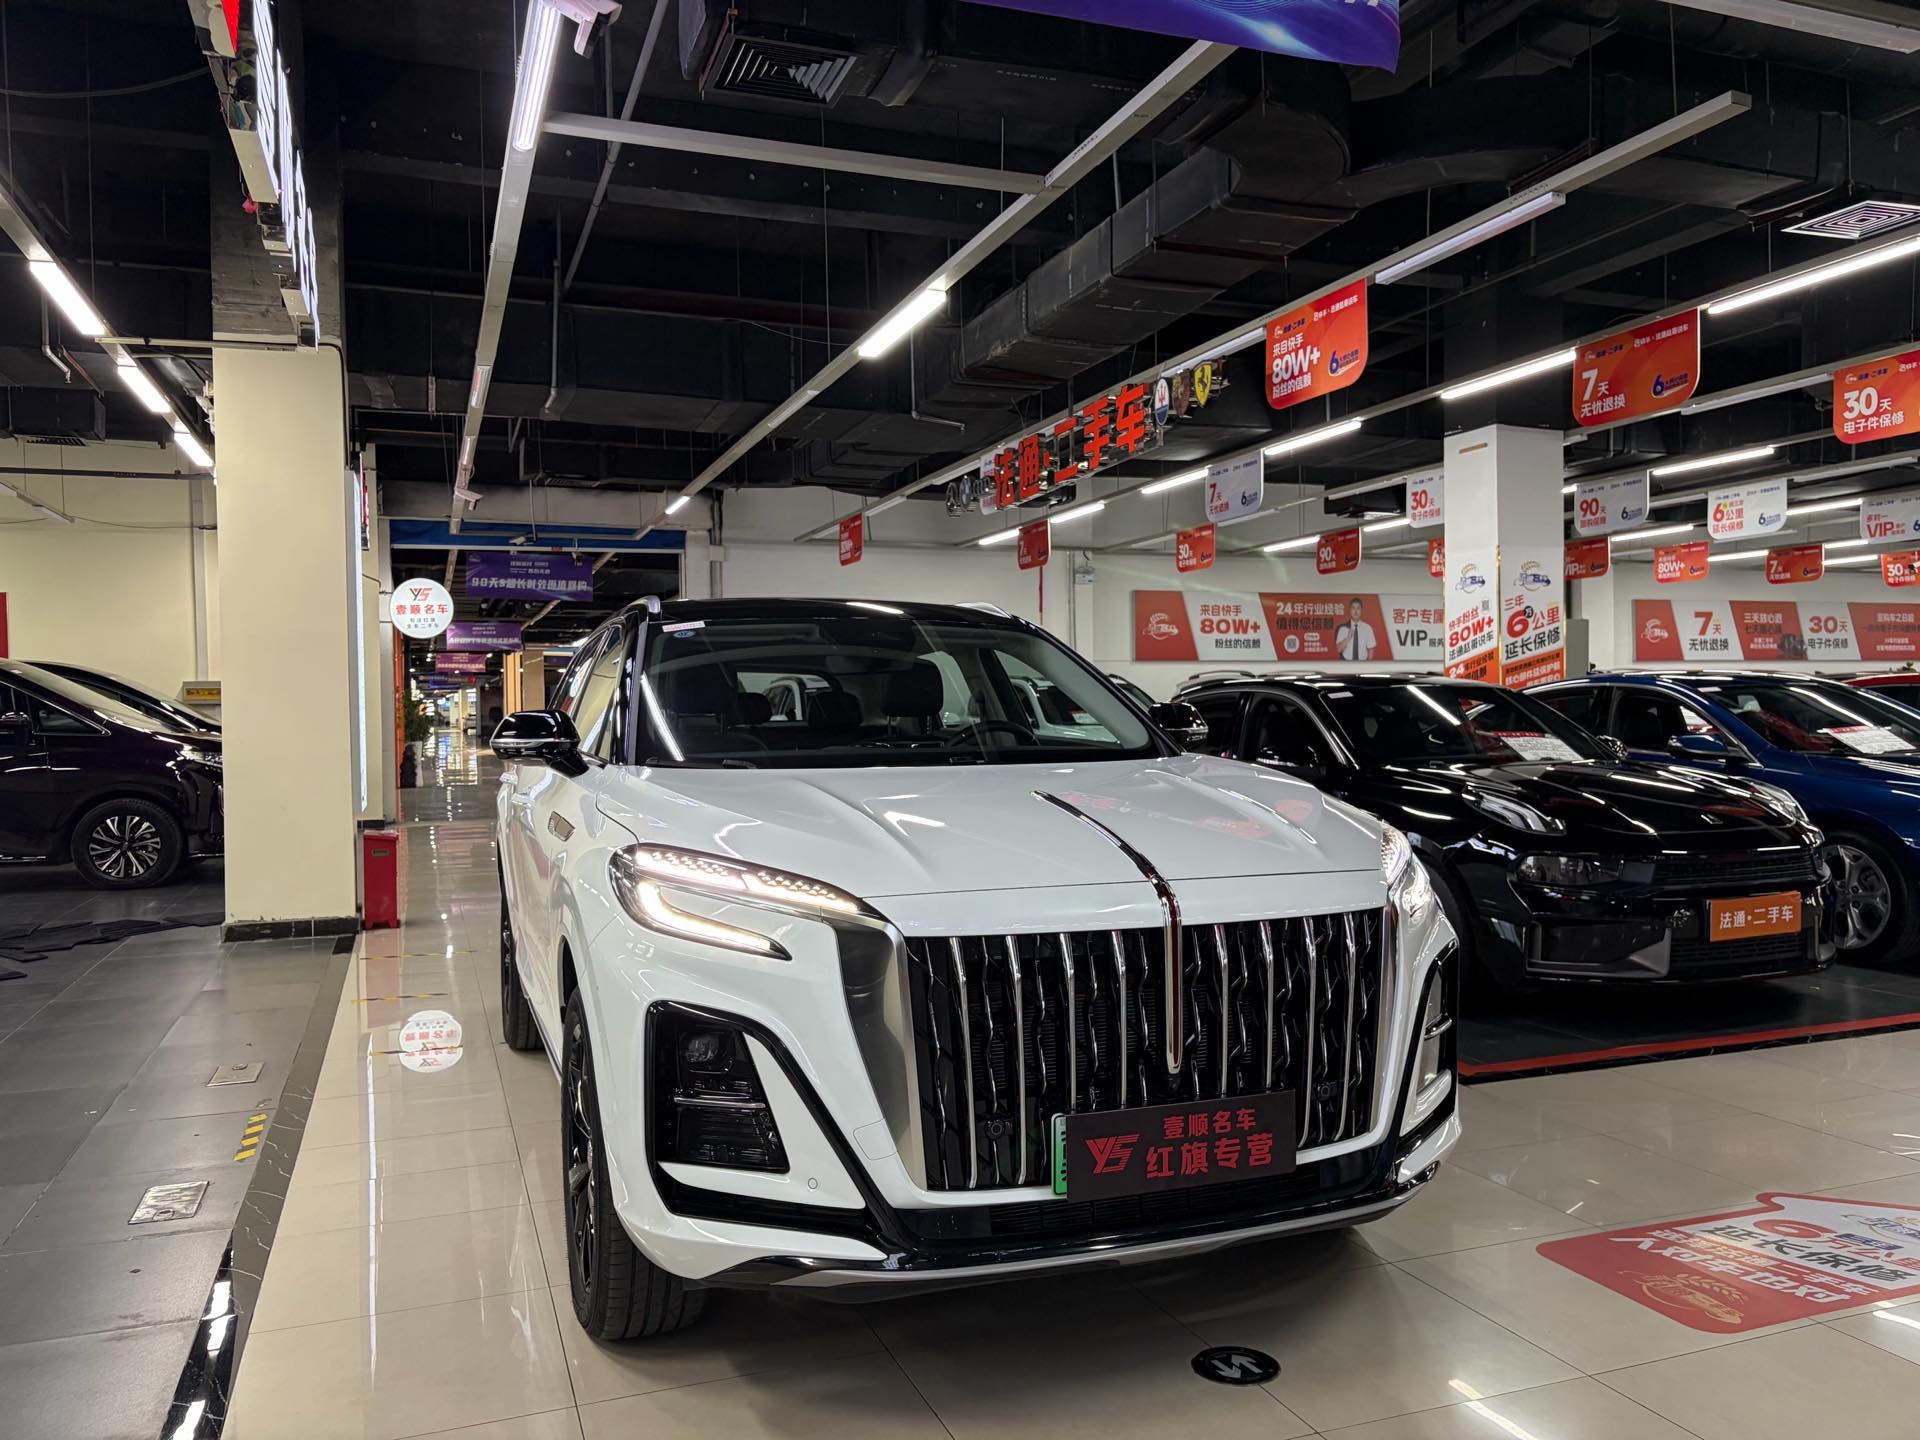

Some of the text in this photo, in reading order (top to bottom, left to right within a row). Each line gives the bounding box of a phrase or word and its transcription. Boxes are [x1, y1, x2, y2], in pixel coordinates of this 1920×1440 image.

[1273, 333, 1304, 357] 来自快手
[1272, 345, 1320, 384] 80W+
[1273, 373, 1312, 399] 粉丝的信赖
[1582, 368, 1609, 401] 7天
[1581, 394, 1626, 418] 无忧退换
[1843, 387, 1892, 419] 30天
[1844, 411, 1905, 434] 电子件保修
[1411, 489, 1436, 511] 30天
[1580, 498, 1606, 517] 90天
[1866, 521, 1895, 538] VIP
[1658, 560, 1685, 573] 80W+
[396, 604, 448, 615] 壹顺名车
[1200, 605, 1242, 617] 来自快手
[1276, 602, 1345, 615] 24年行业经验
[1505, 594, 1524, 611] 三年
[1200, 618, 1261, 635] 80W+
[1449, 606, 1479, 631] 快手粉丝
[1694, 611, 1721, 636] 7天
[1808, 616, 1848, 634] 30天
[1396, 630, 1428, 647] VIP
[1449, 615, 1494, 648] 80W+
[1505, 626, 1561, 660] 延长保修
[1215, 639, 1261, 649] 粉丝的信赖
[1449, 630, 1494, 662] 法通赵哥说车
[1688, 638, 1729, 651] 无忧退换
[1807, 638, 1848, 649] 电子件保修
[1163, 1108, 1257, 1140] 壹顺名车
[1145, 1132, 1274, 1179] 红旗专营
[1700, 1224, 1918, 1282] 延长保修
[1608, 1237, 1852, 1303] 人对车也对
